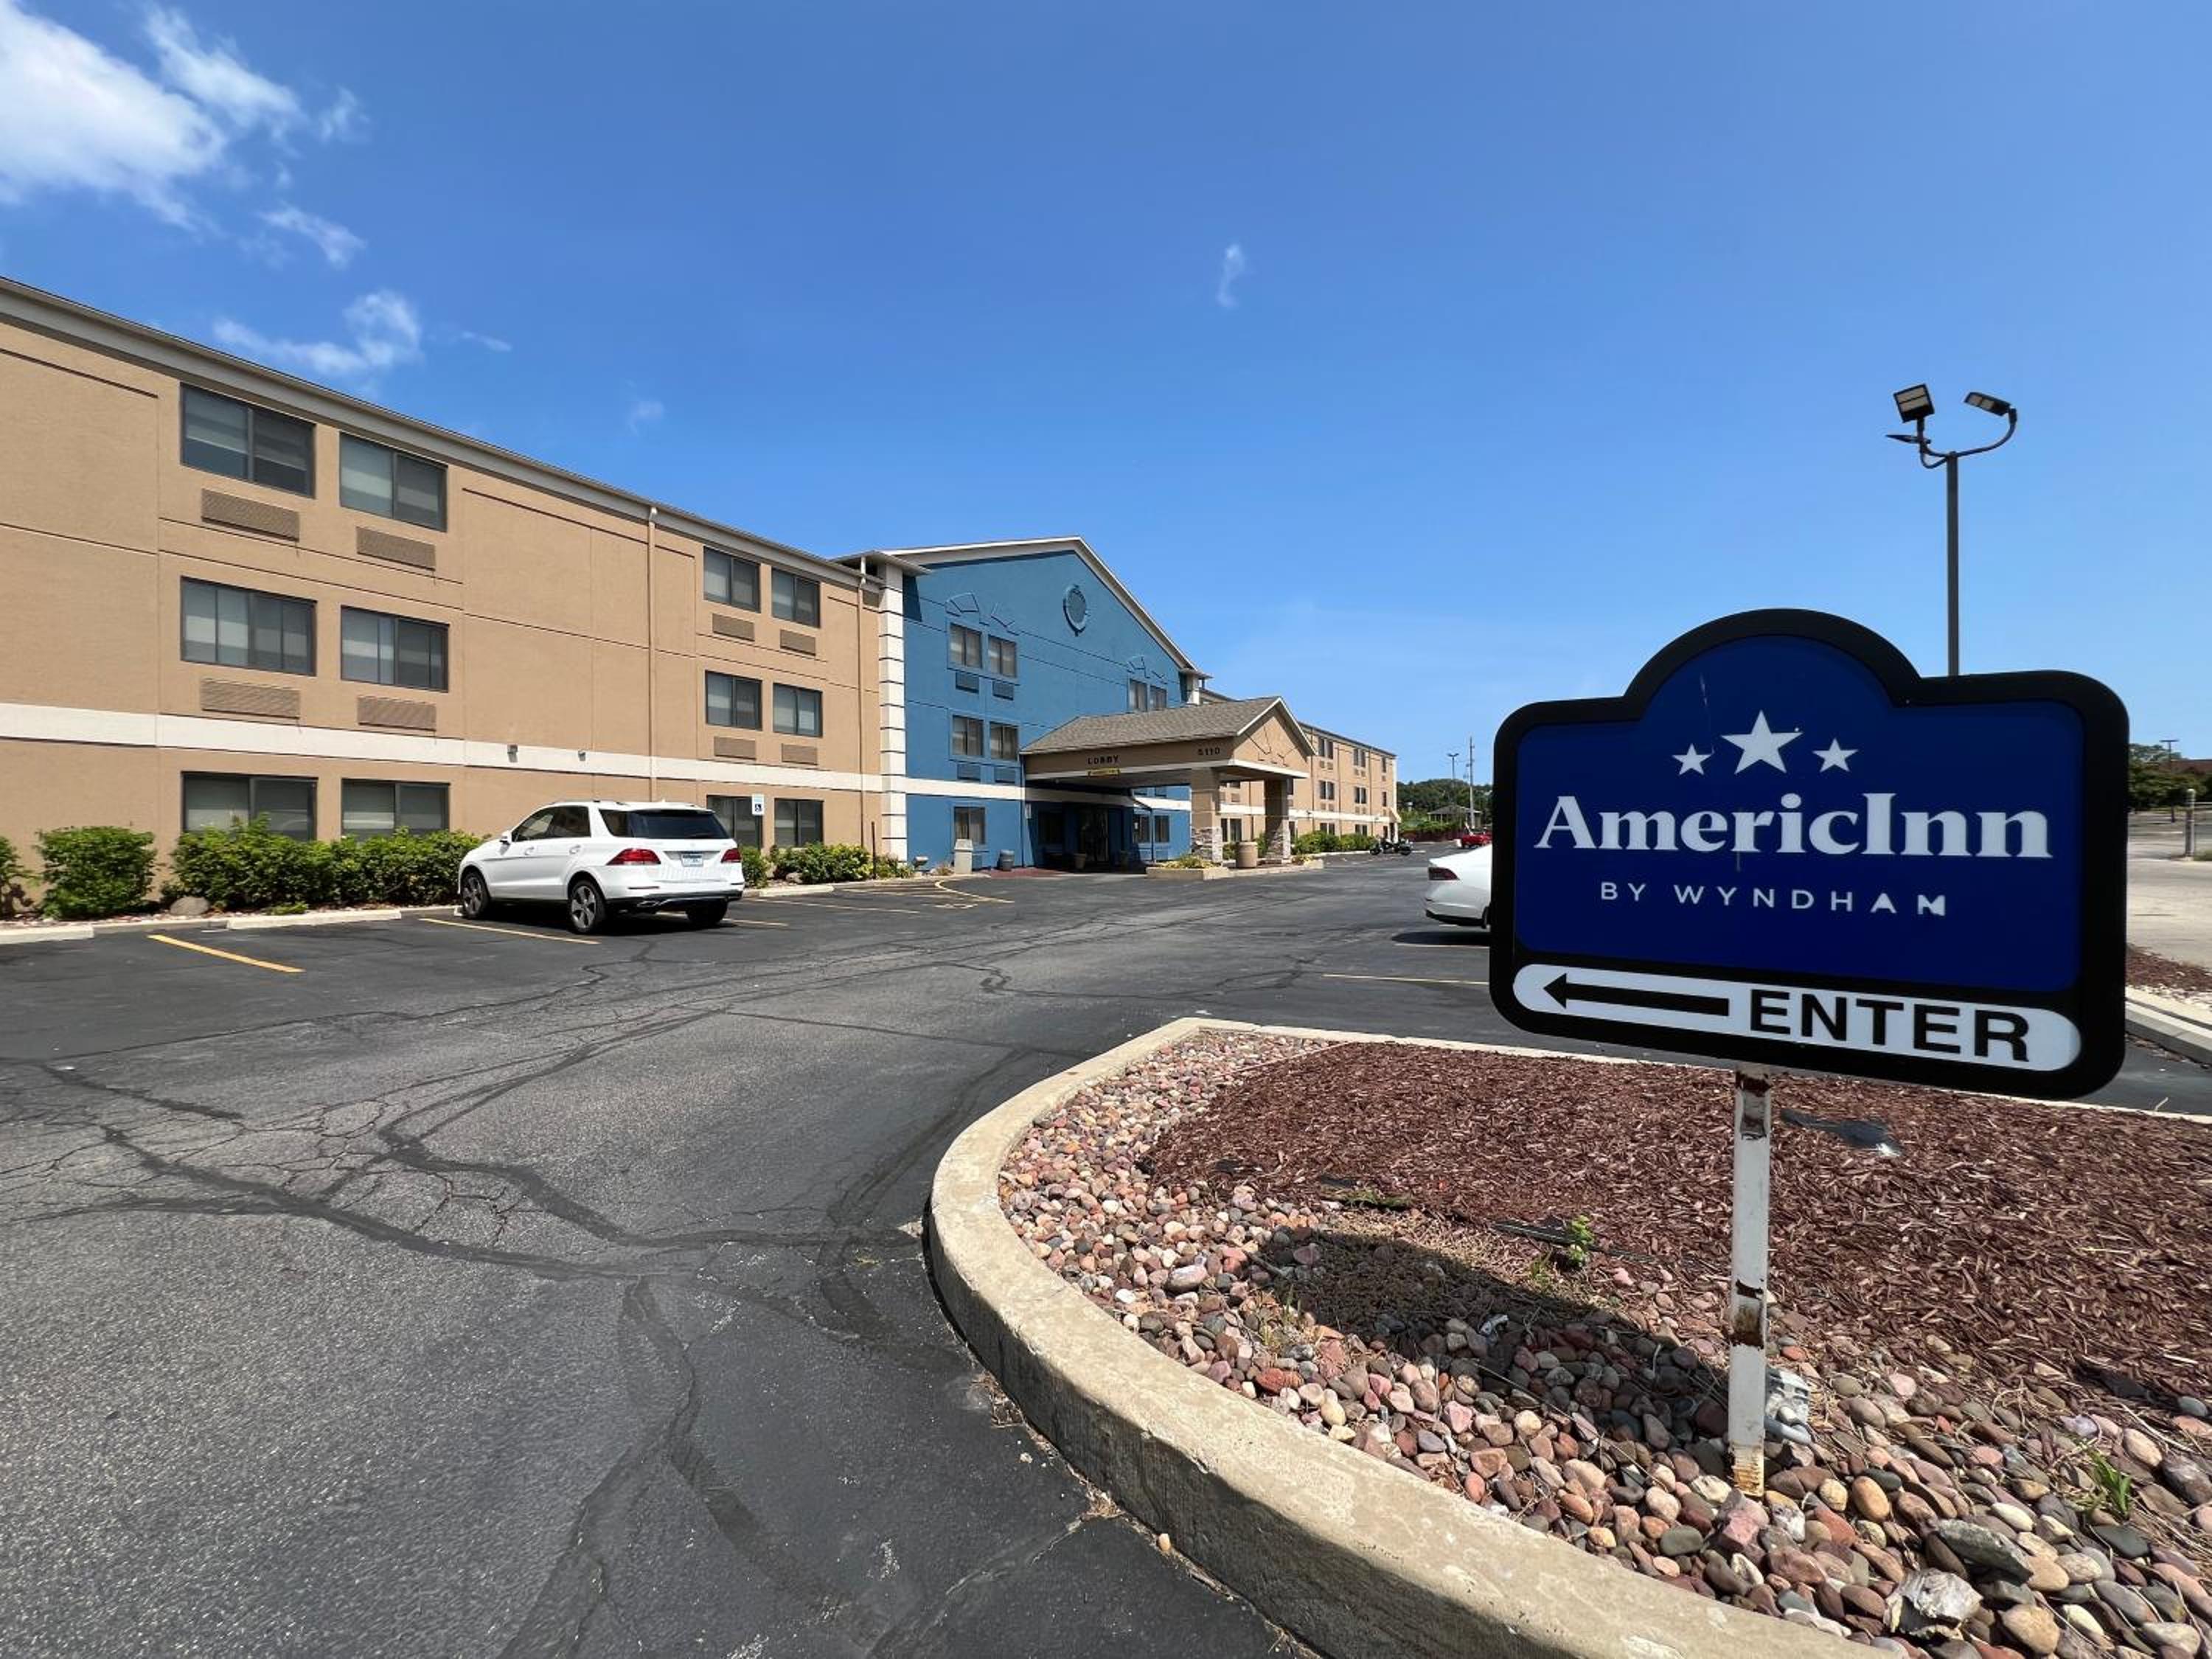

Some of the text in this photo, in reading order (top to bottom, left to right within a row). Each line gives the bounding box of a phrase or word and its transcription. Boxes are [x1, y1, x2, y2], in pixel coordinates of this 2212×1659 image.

[1534, 793, 2053, 858] AmericInn
[1601, 882, 1946, 916] BY WYNDHAM
[1750, 988, 2030, 1062] ENTER
